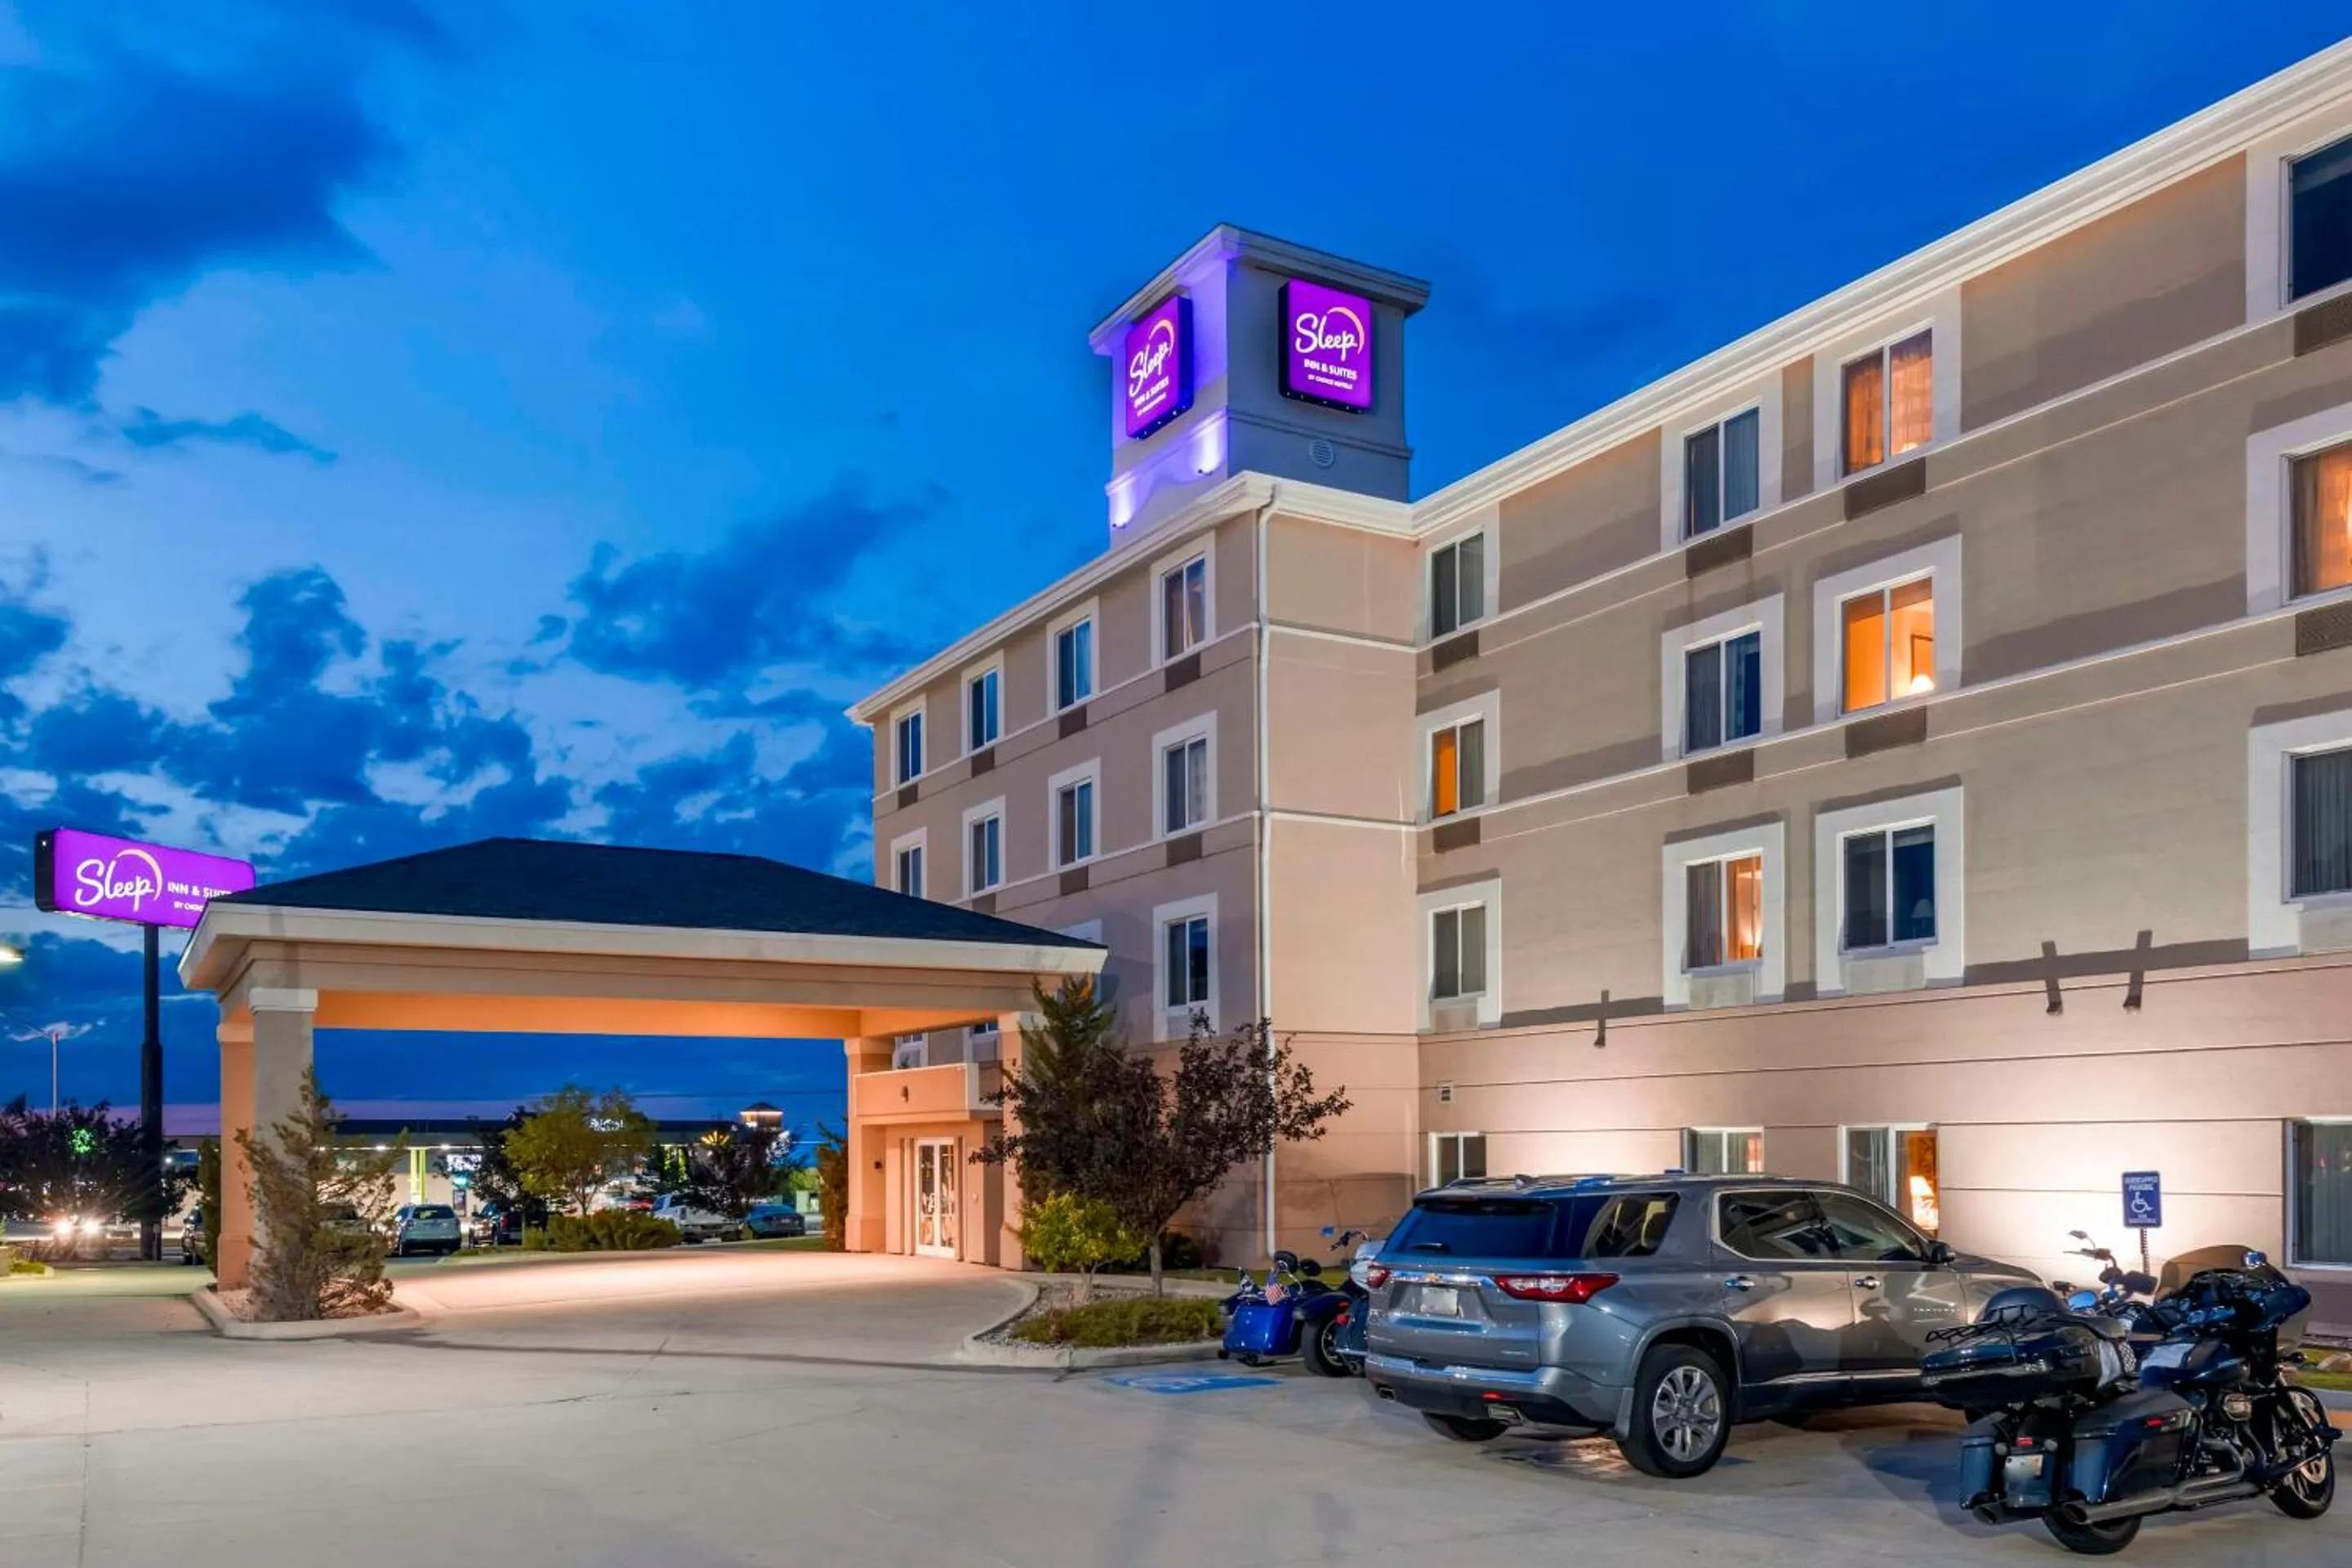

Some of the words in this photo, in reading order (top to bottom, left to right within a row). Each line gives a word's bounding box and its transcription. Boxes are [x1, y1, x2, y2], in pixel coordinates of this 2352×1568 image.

[1294, 313, 1358, 362] Sleep
[1129, 341, 1169, 398] Sleep
[1329, 364, 1357, 381] SUITES
[74, 858, 154, 912] Sleep
[167, 881, 189, 895] INN
[192, 885, 200, 896] &
[203, 887, 232, 898] SUIT
